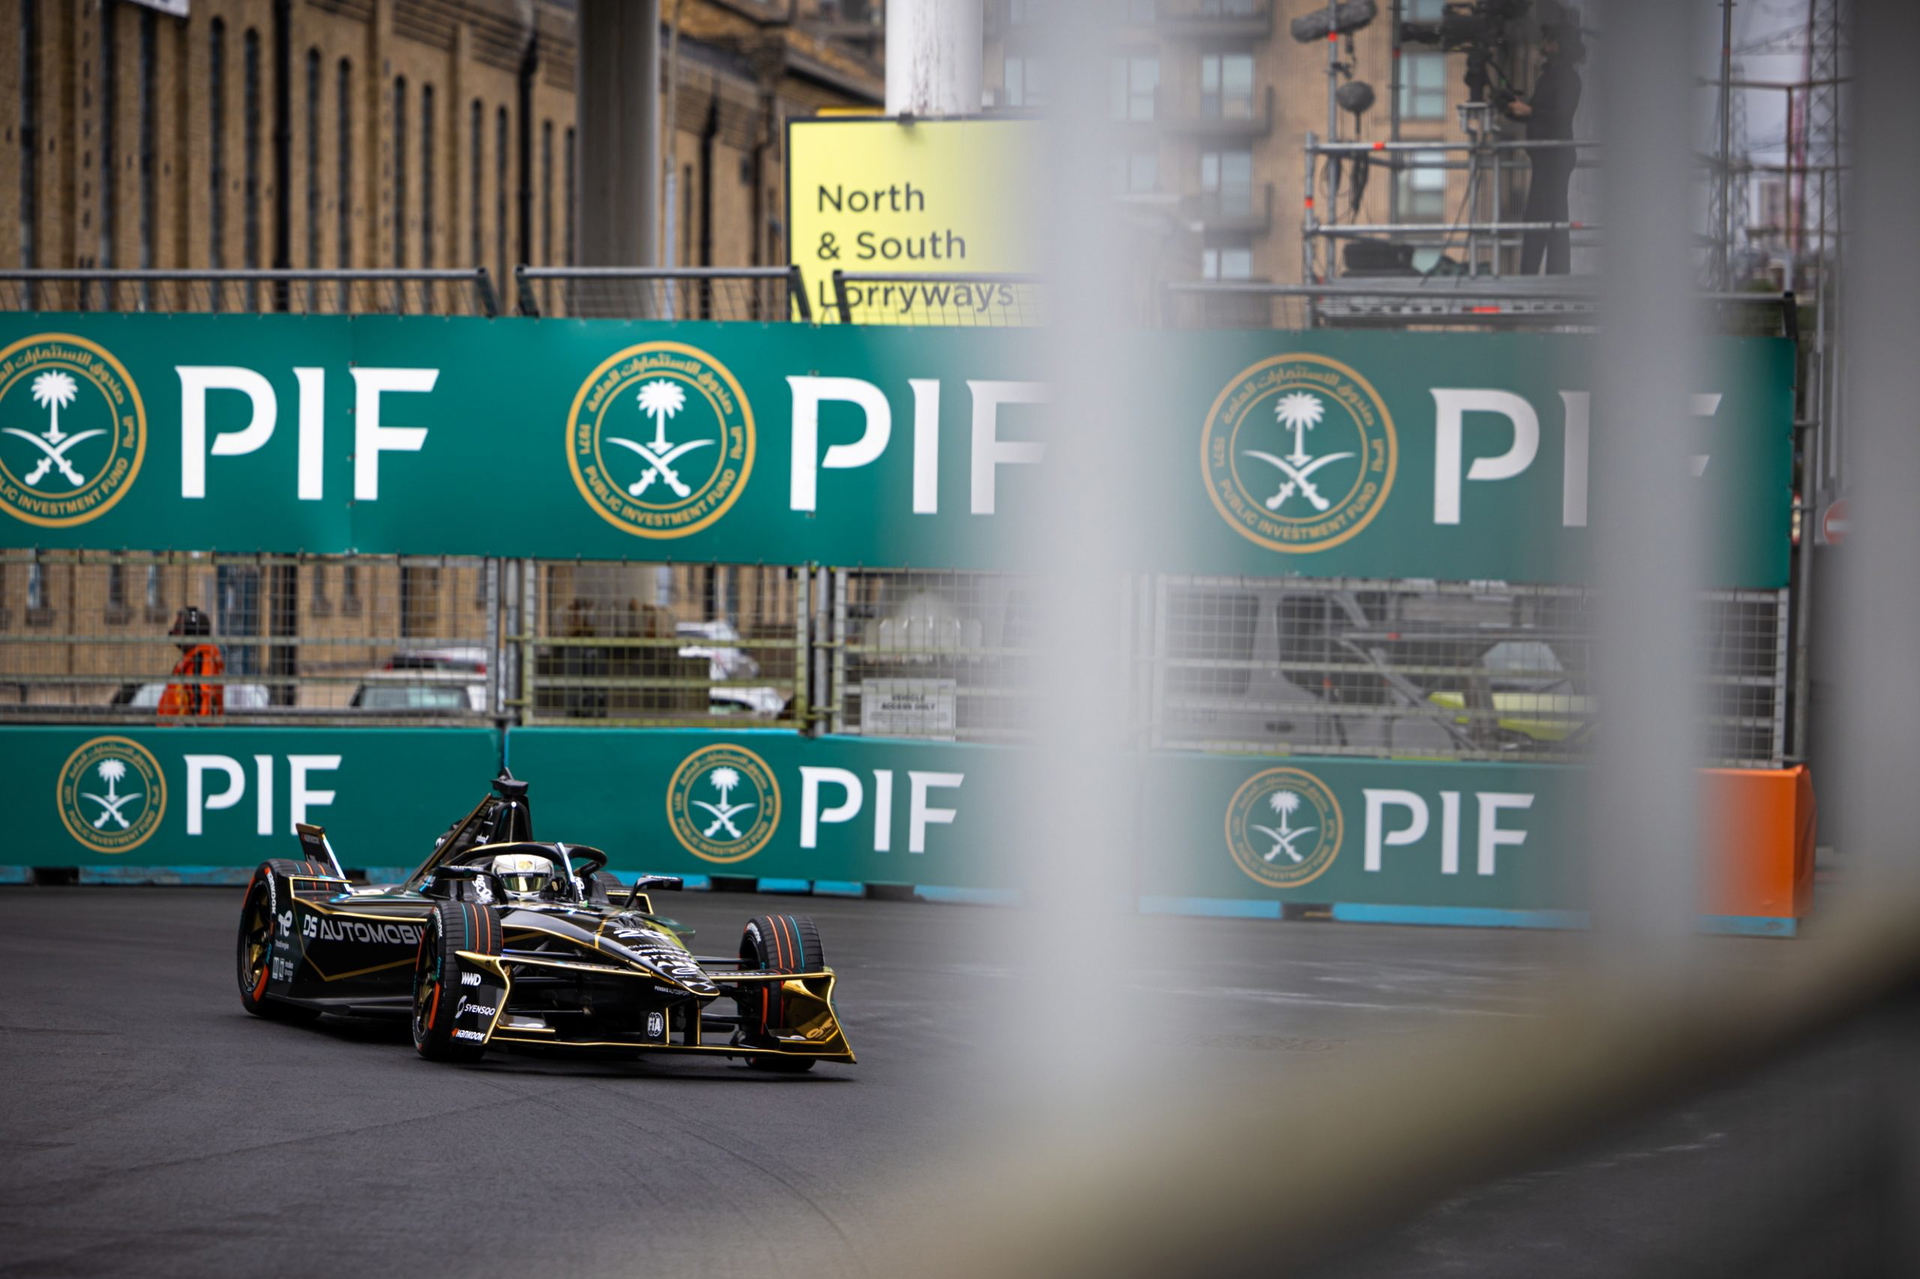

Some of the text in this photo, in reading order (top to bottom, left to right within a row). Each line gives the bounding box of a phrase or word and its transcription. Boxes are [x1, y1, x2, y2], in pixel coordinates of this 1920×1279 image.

[818, 182, 925, 212] North
[817, 229, 966, 260] & South
[819, 280, 1014, 313] Lorryways
[175, 365, 440, 500] PIF
[785, 375, 1051, 514] PIF
[0, 458, 129, 515] LIC INVESTMENT FUND
[584, 465, 736, 526] PUBLIC INVESTMENT FUND
[183, 754, 342, 835] PIF
[799, 766, 965, 853] PIF
[1362, 788, 1535, 875] PIF
[303, 914, 318, 938] DS
[464, 1003, 495, 1016] SYENSQO
